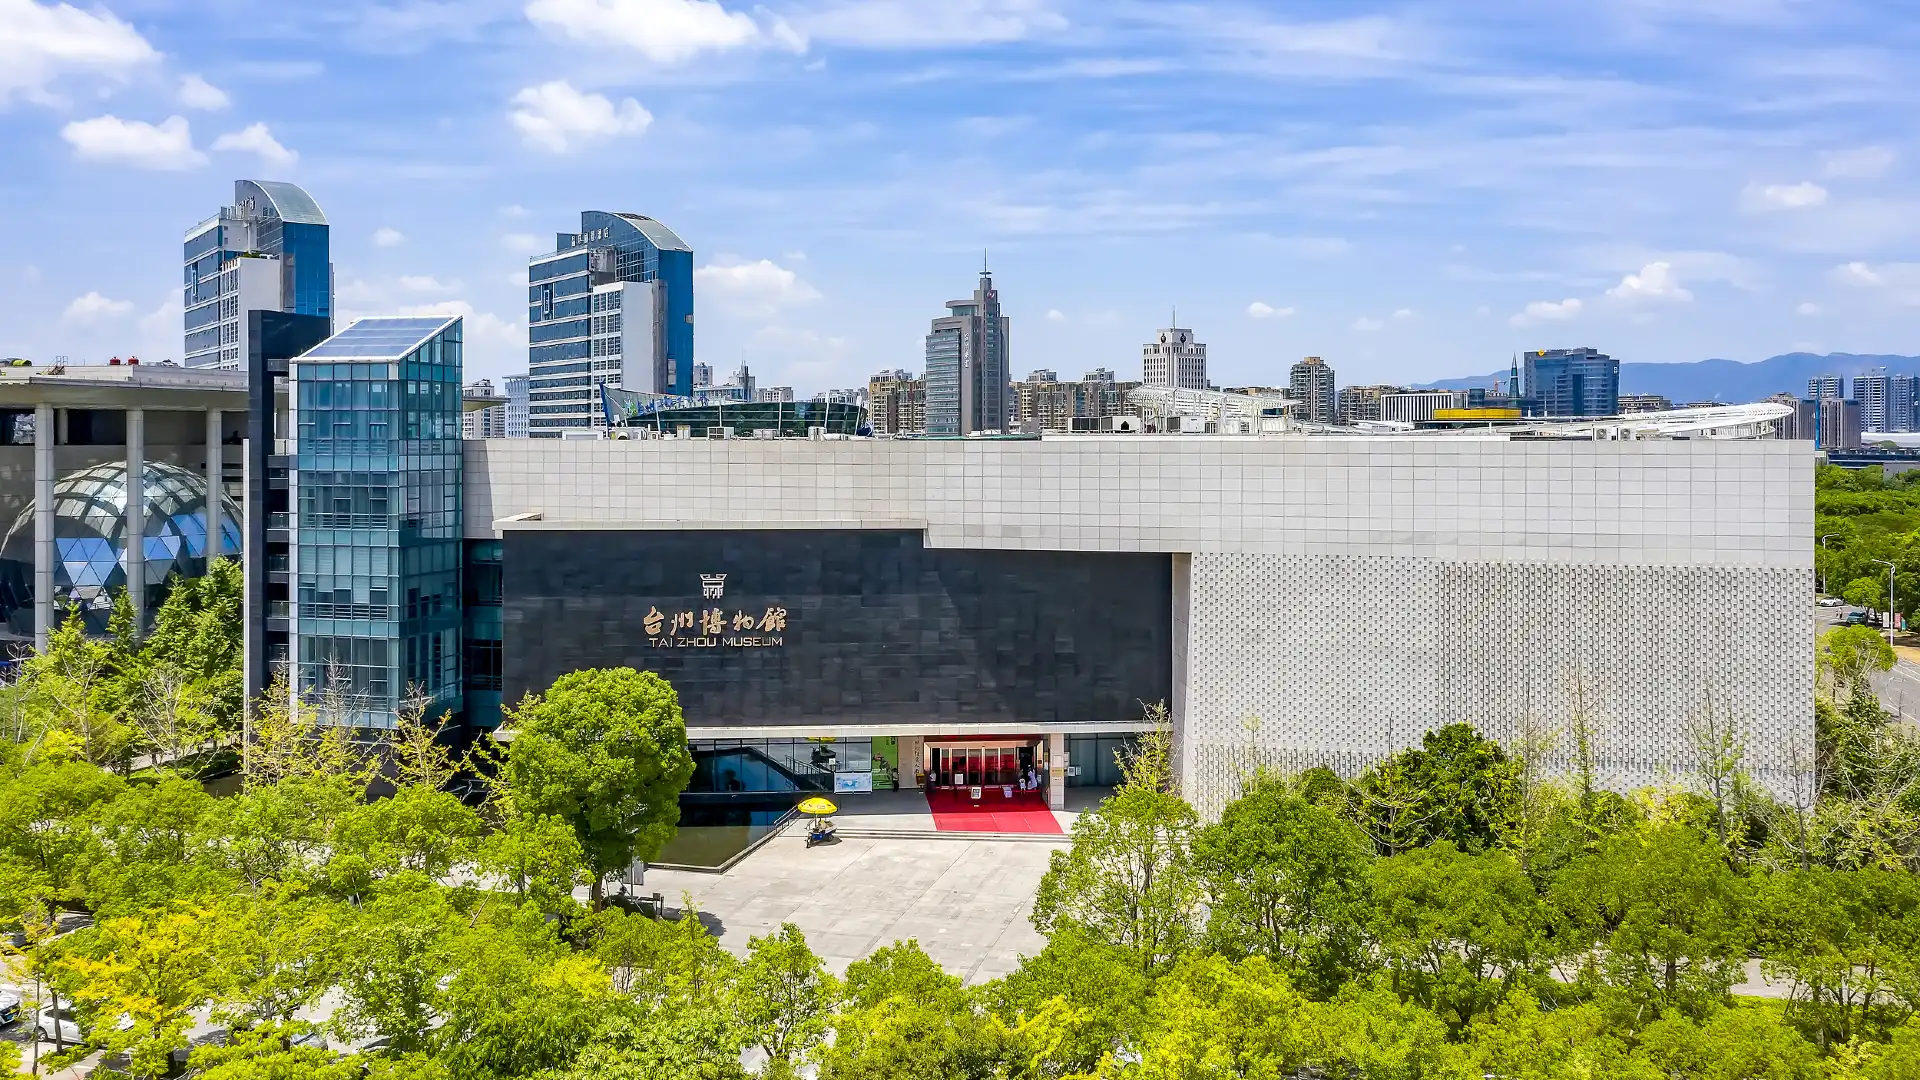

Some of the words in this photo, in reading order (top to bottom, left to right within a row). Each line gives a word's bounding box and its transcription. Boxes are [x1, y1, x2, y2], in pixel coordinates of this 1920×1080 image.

[648, 637, 673, 648] TAI
[676, 637, 717, 648] ZHOU
[722, 636, 783, 647] MUSEUM
